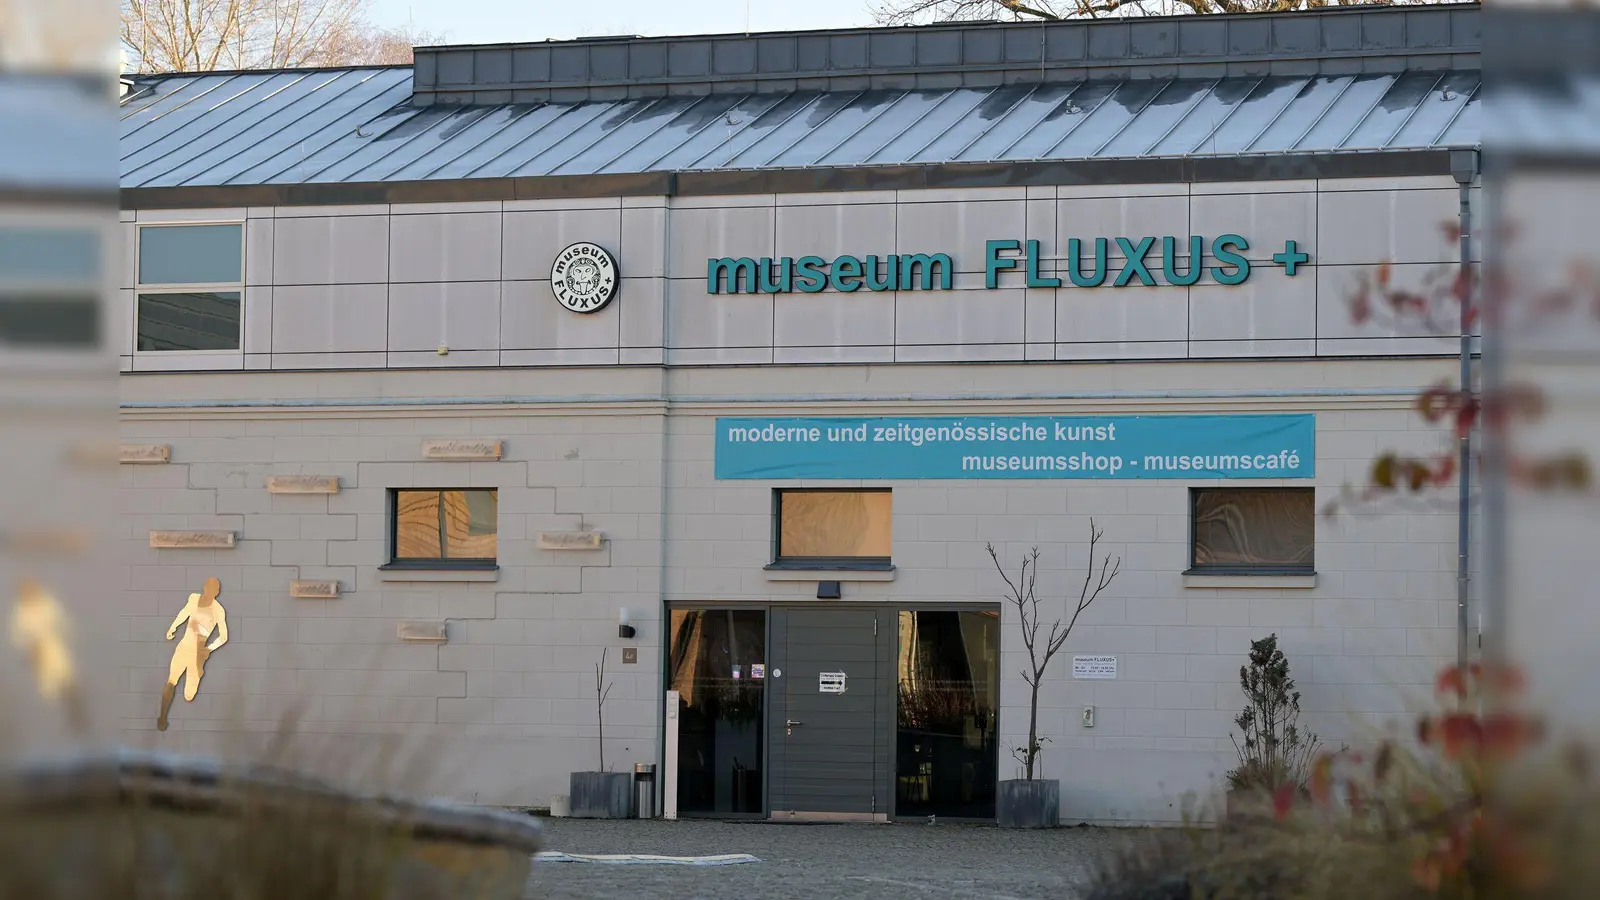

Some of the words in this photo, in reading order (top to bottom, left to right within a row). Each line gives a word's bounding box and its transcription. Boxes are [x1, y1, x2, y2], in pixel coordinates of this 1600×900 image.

[555, 246, 609, 274] museum
[706, 252, 953, 295] museum
[985, 234, 1250, 289] FLUXUS
[1273, 240, 1309, 276] +
[554, 279, 609, 308] FLUXUS
[728, 423, 821, 442] moderne
[827, 423, 867, 442] und
[873, 422, 1047, 446] zeitgenössische
[1055, 422, 1116, 441] kunst
[962, 451, 1123, 475] museumsshop
[1144, 449, 1300, 471] museumscafé
